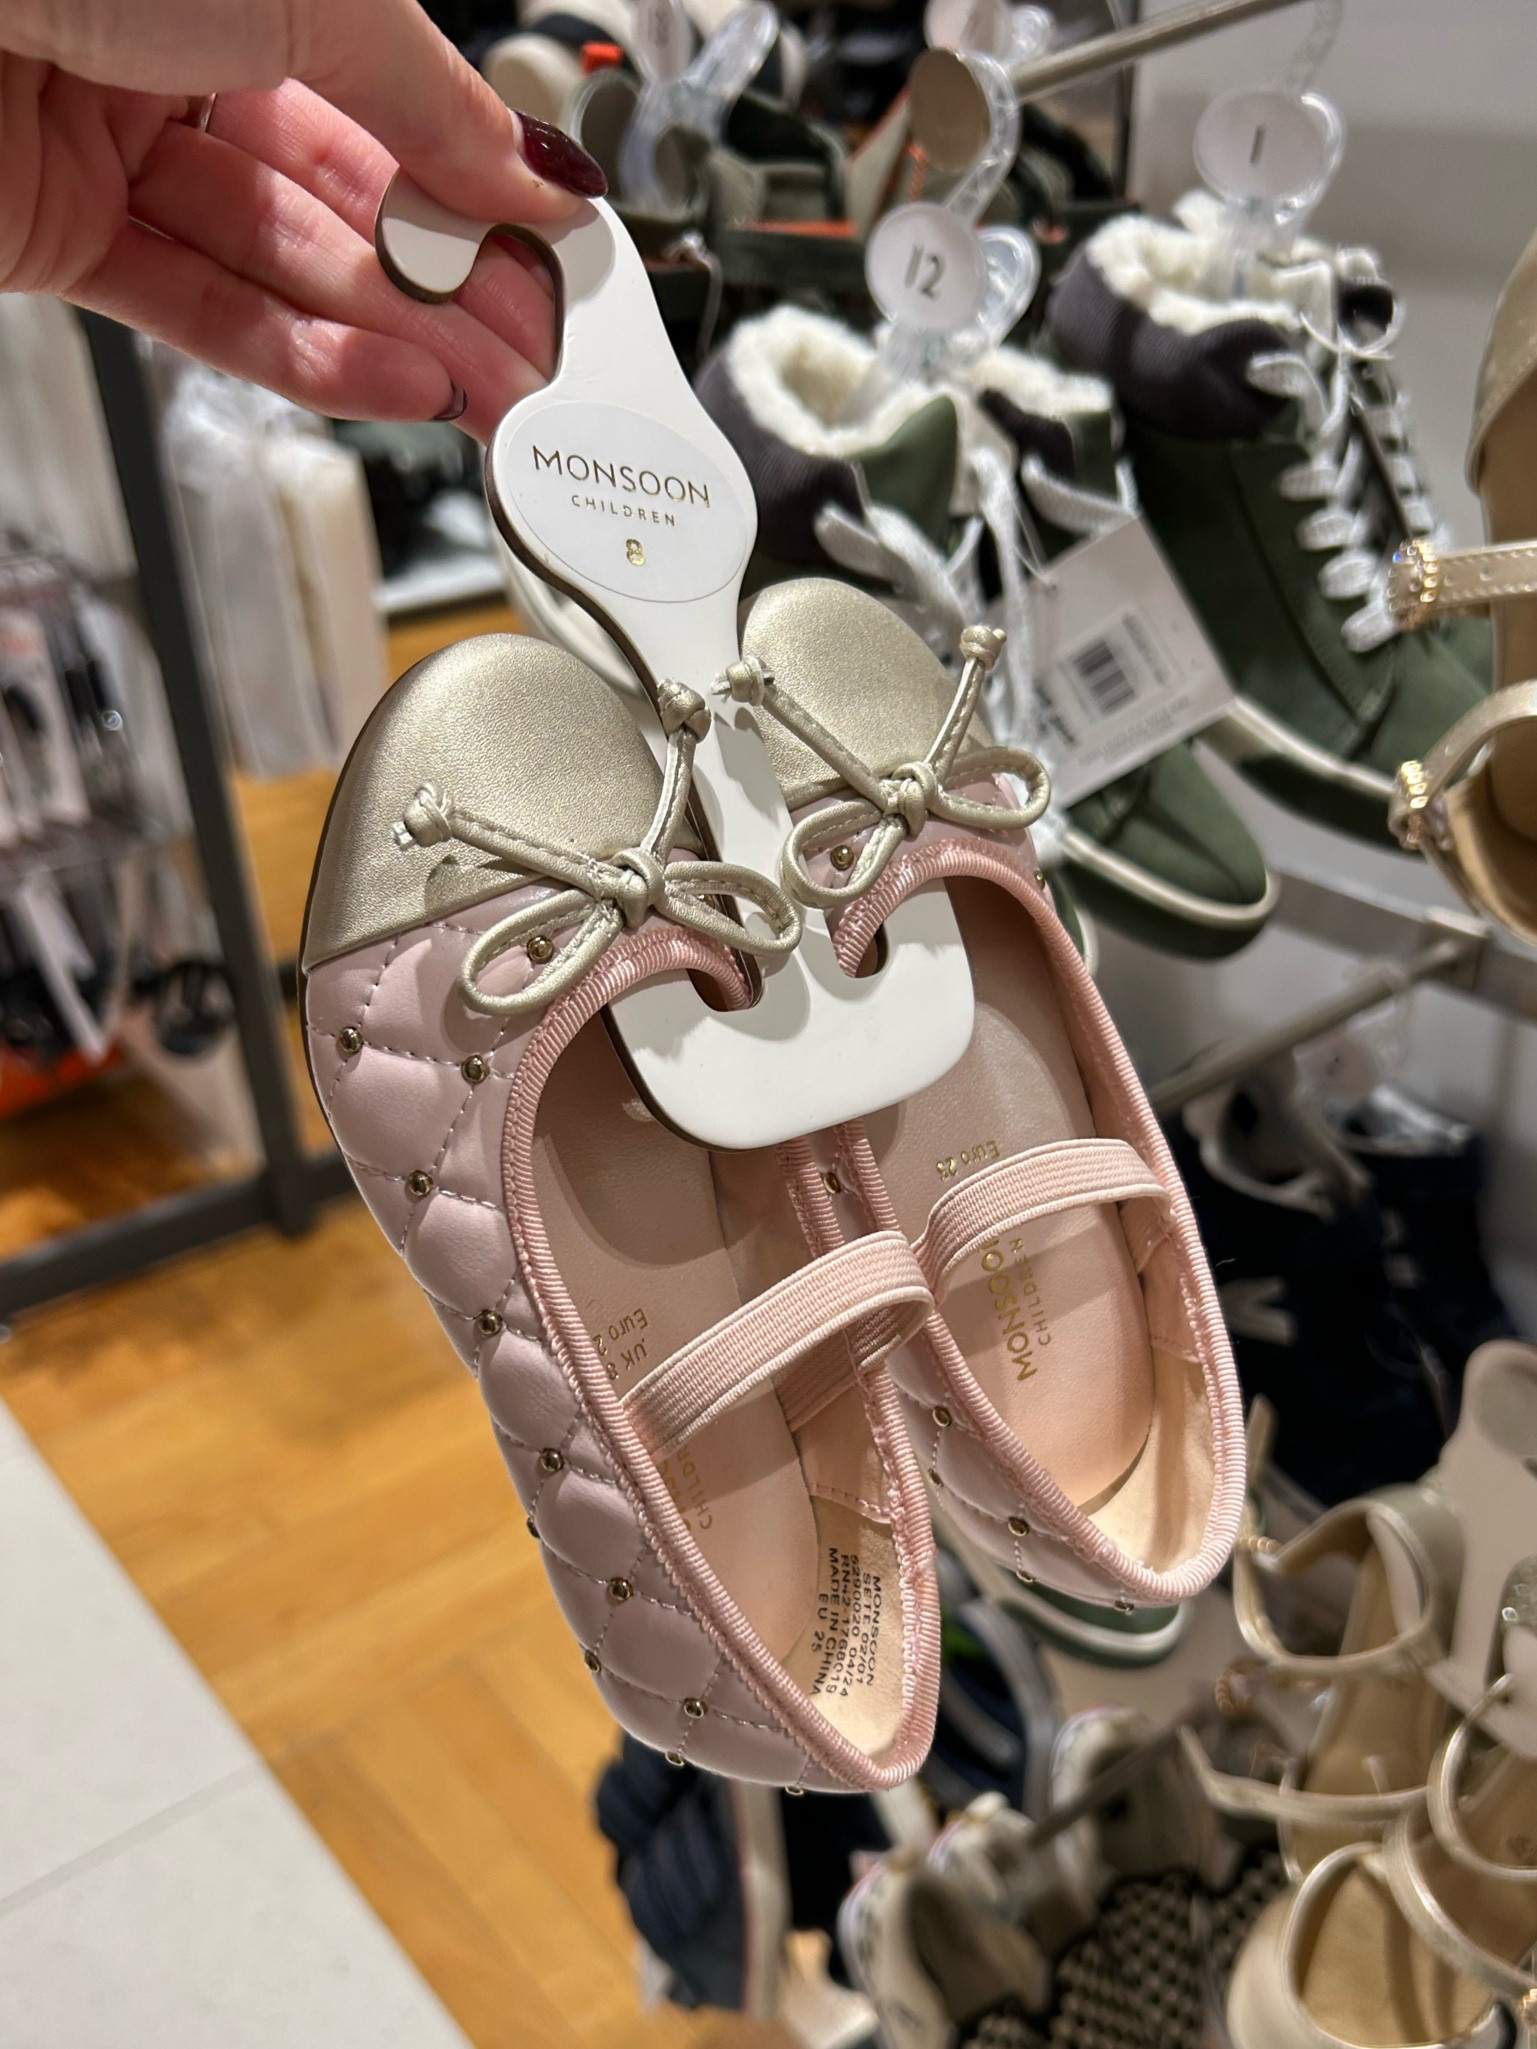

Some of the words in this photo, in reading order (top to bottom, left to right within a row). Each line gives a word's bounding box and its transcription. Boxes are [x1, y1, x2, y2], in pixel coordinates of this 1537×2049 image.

[905, 245, 945, 299] 12
[532, 445, 710, 508] MONSOON
[571, 494, 676, 527] CHILDREN
[625, 538, 646, 566] 8
[961, 1140, 1000, 1166] Euro
[1009, 1237, 1051, 1346] CHILDREN
[609, 1308, 648, 1341] Euro
[606, 1363, 620, 1380] 8
[621, 1342, 648, 1371] UK
[676, 1445, 713, 1530] CHILDR
[829, 1547, 840, 1605] MADE
[818, 1593, 829, 1619] EU
[829, 1611, 839, 1631] IN
[811, 1630, 825, 1652] 25
[867, 1575, 882, 1686] MONSOON
[810, 1637, 837, 1695] CHINA
[839, 1647, 857, 1697] 04/24
[856, 1632, 869, 1683] 02/01
